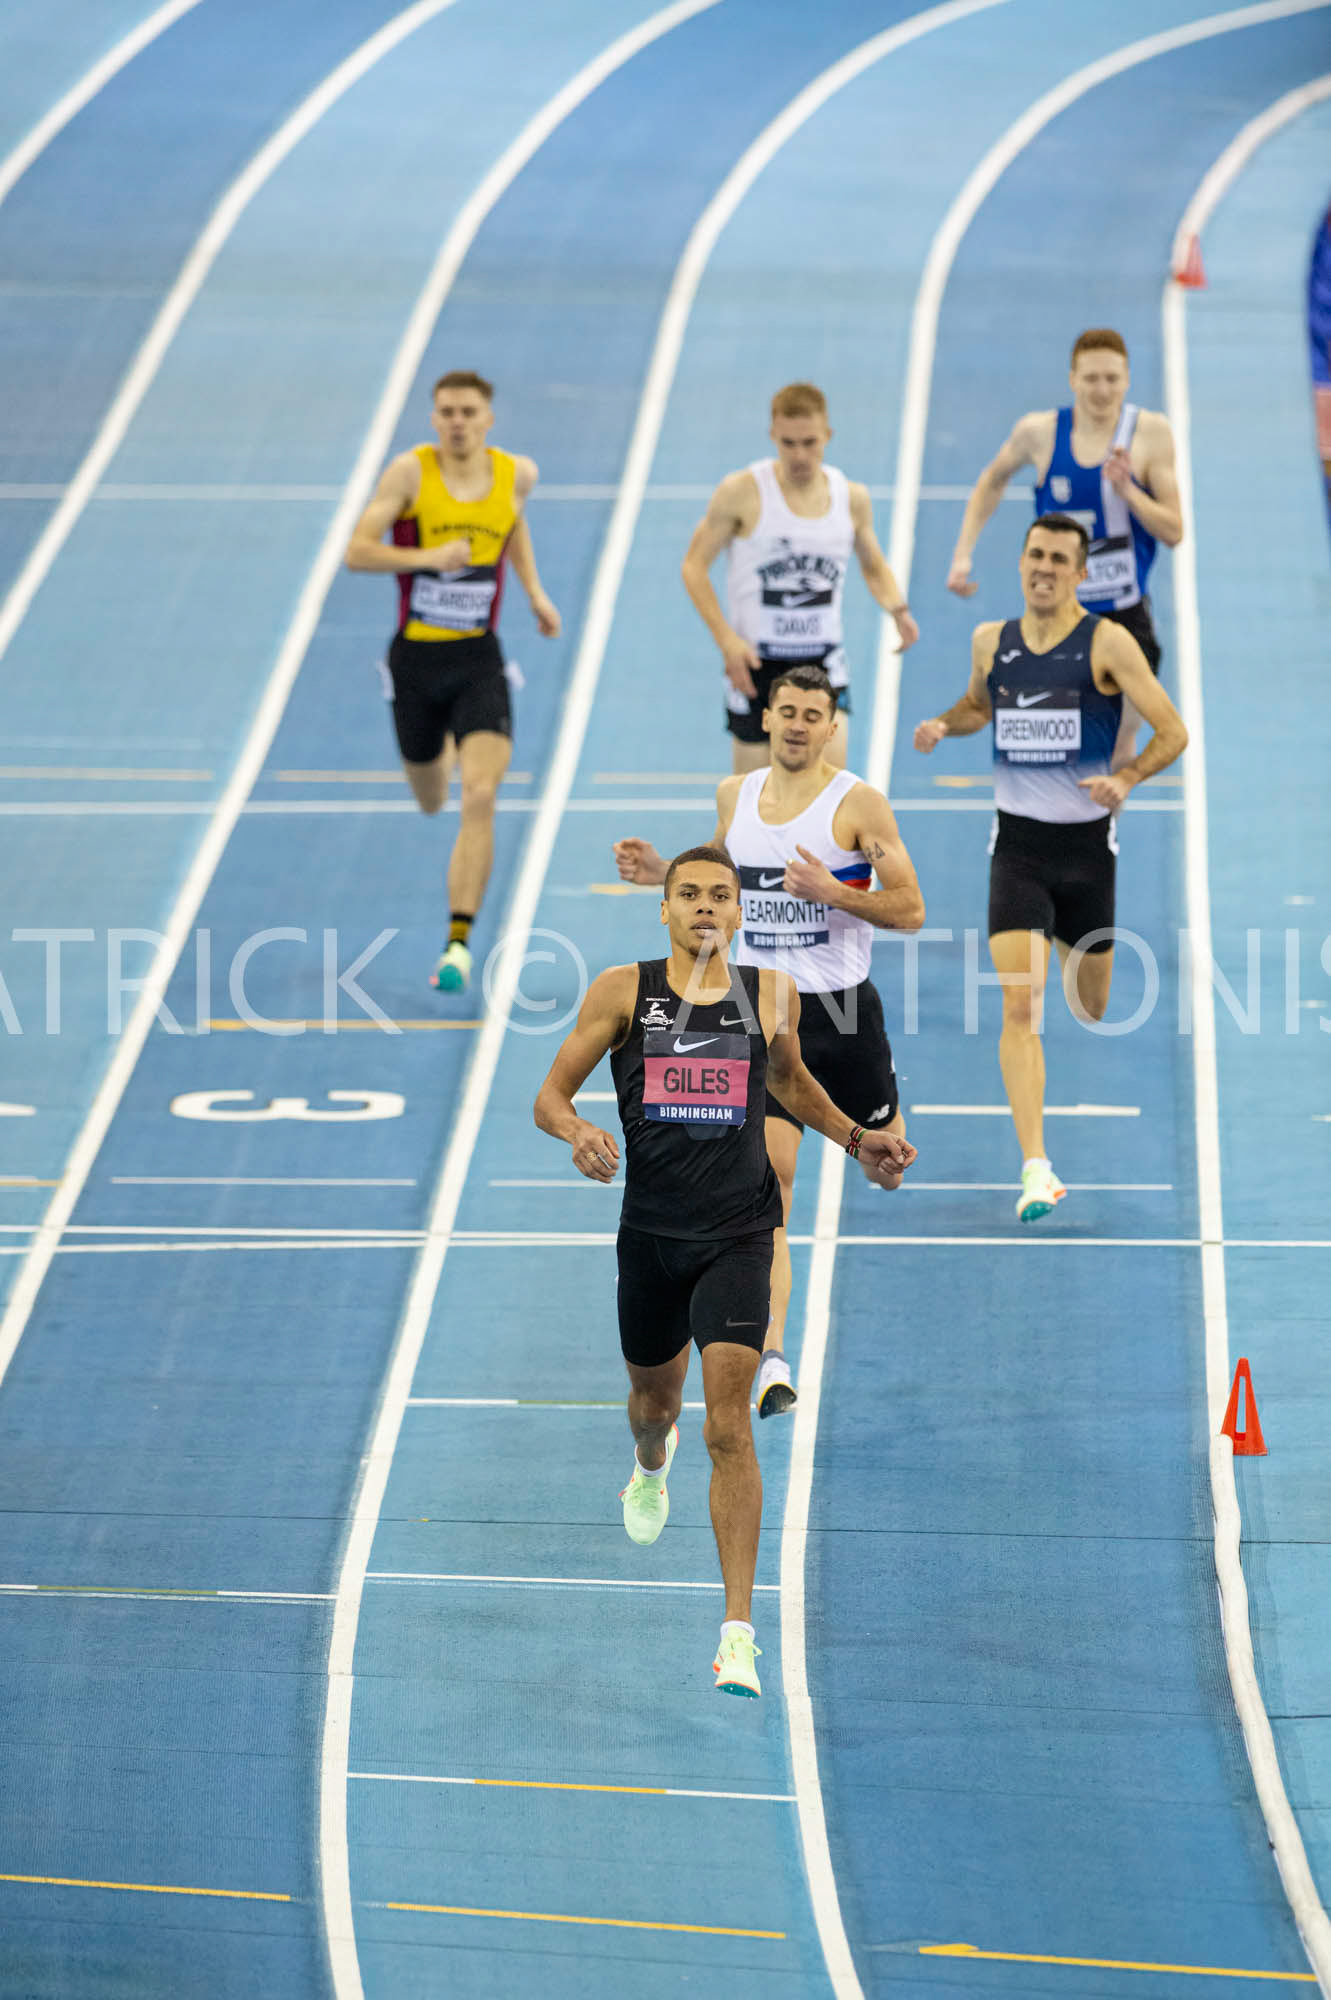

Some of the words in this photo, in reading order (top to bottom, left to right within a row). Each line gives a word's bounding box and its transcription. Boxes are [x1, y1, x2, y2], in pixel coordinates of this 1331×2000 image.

[1001, 718, 1076, 741] GREENWOOD
[745, 899, 825, 923] LEARMONTH
[663, 1067, 730, 1095] GILES
[660, 1106, 733, 1120] BIRMINGHAM
